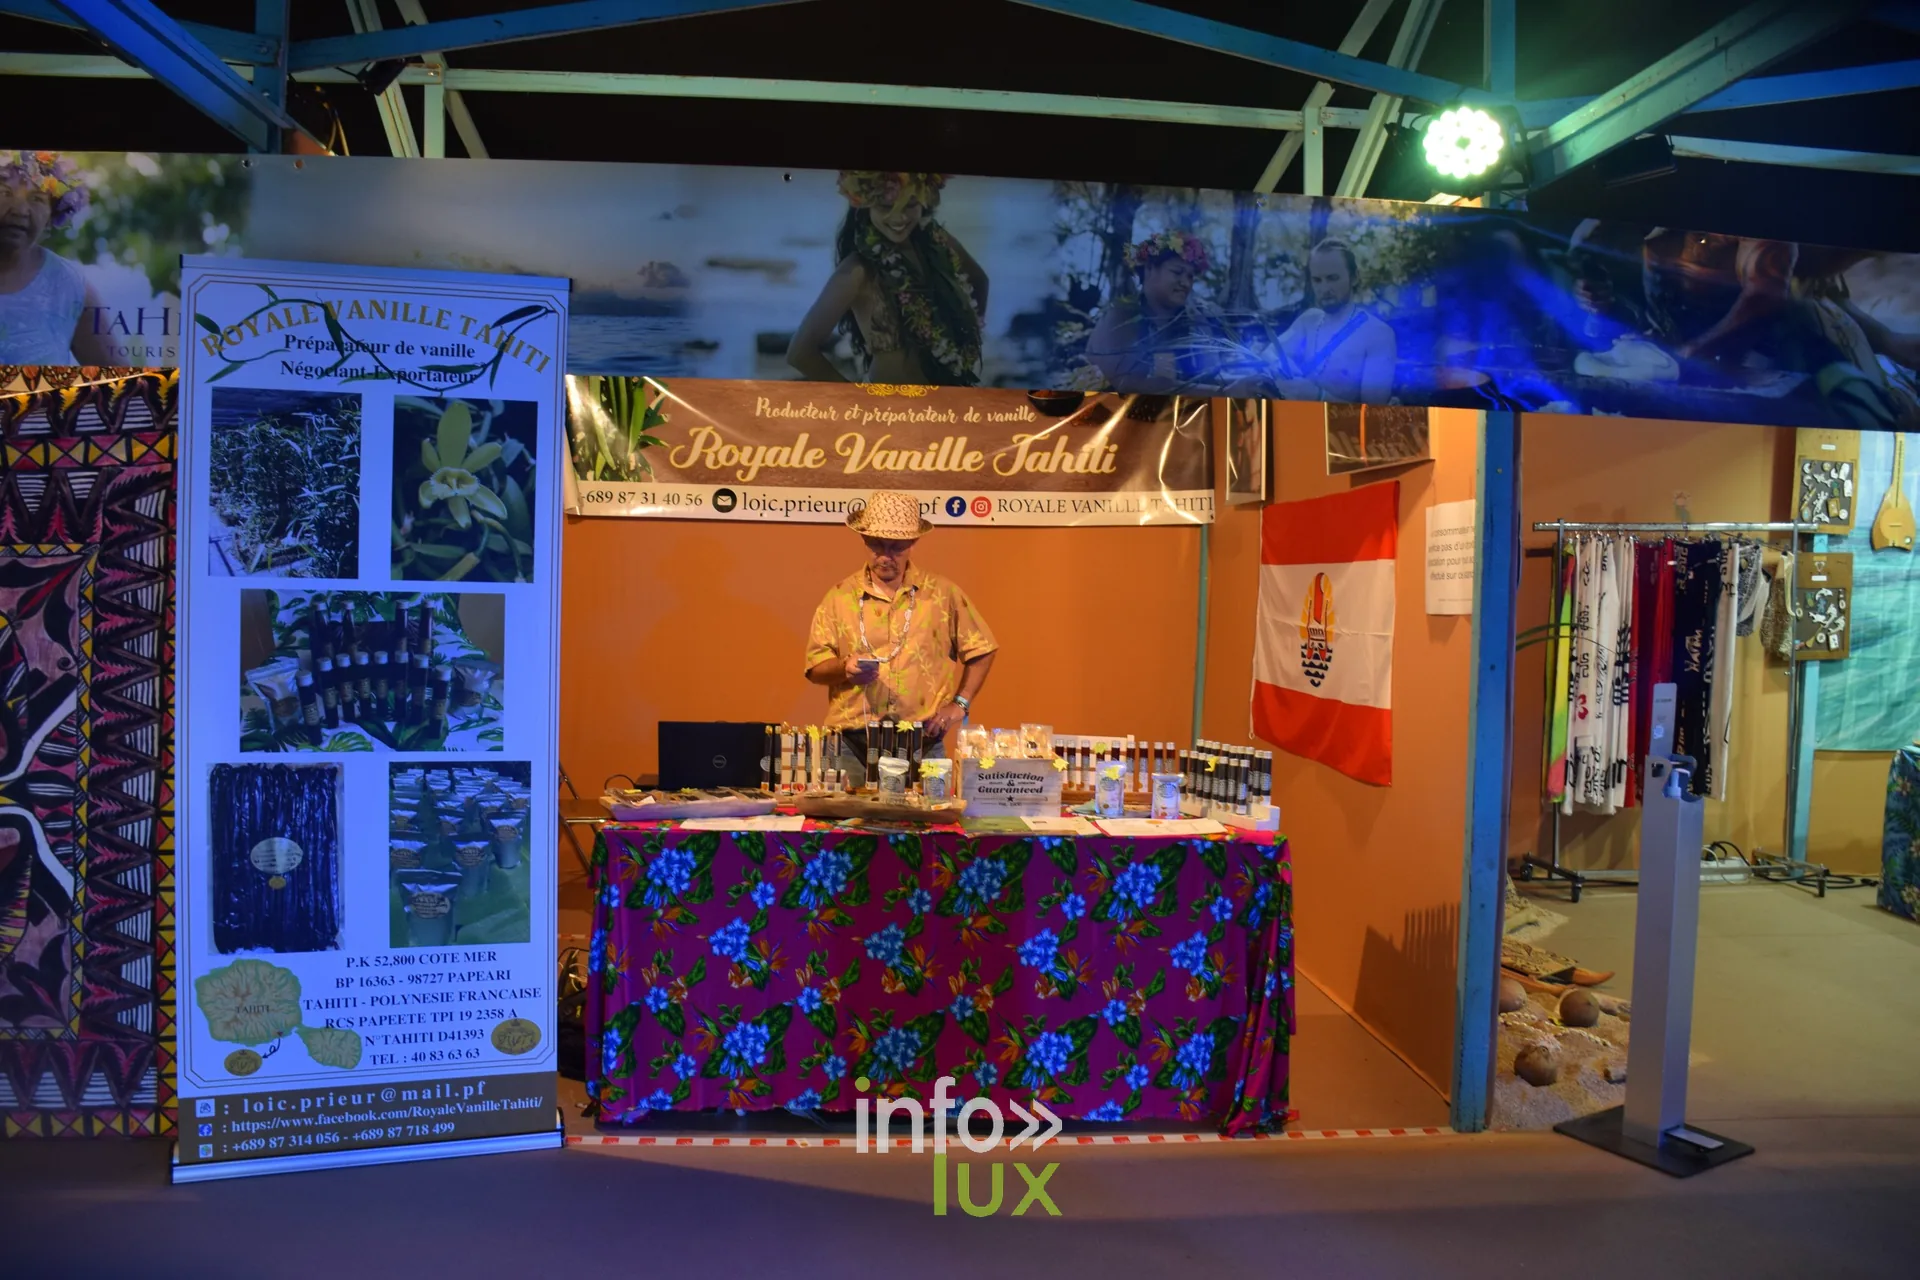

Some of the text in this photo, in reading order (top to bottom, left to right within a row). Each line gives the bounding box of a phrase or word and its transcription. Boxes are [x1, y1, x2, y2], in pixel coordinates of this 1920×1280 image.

[201, 299, 551, 374] ROYALE VANILLE TAHITI
[284, 334, 476, 358] Prépaateur de vanille
[755, 396, 1037, 427] Producteur et préparateur de vanille
[669, 426, 1118, 482] Royale Vanille Tahiti
[617, 491, 636, 505] 87
[640, 491, 657, 505] 31
[662, 492, 680, 506] 40
[685, 493, 703, 506] 56
[997, 498, 1067, 513] ROYALE
[1150, 496, 1214, 513] THITI
[978, 771, 1044, 782] Satisfaction
[1006, 779, 1015, 787] &
[978, 785, 1043, 794] Guaranteed
[346, 951, 497, 968] P.K 52,800 COTE MER
[335, 977, 354, 989] BP
[359, 975, 395, 988] 16363
[407, 972, 444, 985] 98727
[447, 969, 512, 983] PAPEARI
[235, 1003, 270, 1014] TAHITI
[303, 996, 357, 1010] TAHITI
[370, 991, 455, 1007] POLYNESIE
[458, 987, 542, 1002] FRANCAISE
[325, 1007, 518, 1029] RCS PAPEETE TPI 19 2358 A
[438, 1028, 485, 1042] D41393
[369, 1052, 399, 1066] TEL
[410, 1051, 426, 1063] 40
[429, 1049, 444, 1062] 83
[447, 1048, 462, 1061] 63
[465, 1047, 480, 1060] 63
[243, 1080, 487, 1114] loic.prieur@mail.pf
[232, 1138, 266, 1152] +689
[268, 1136, 285, 1149] 87
[288, 1133, 313, 1147] 314
[315, 1131, 340, 1145] 056
[352, 1127, 384, 1142] +689
[387, 1126, 402, 1139] 87
[406, 1124, 430, 1137] 718
[432, 1121, 455, 1135] 499
